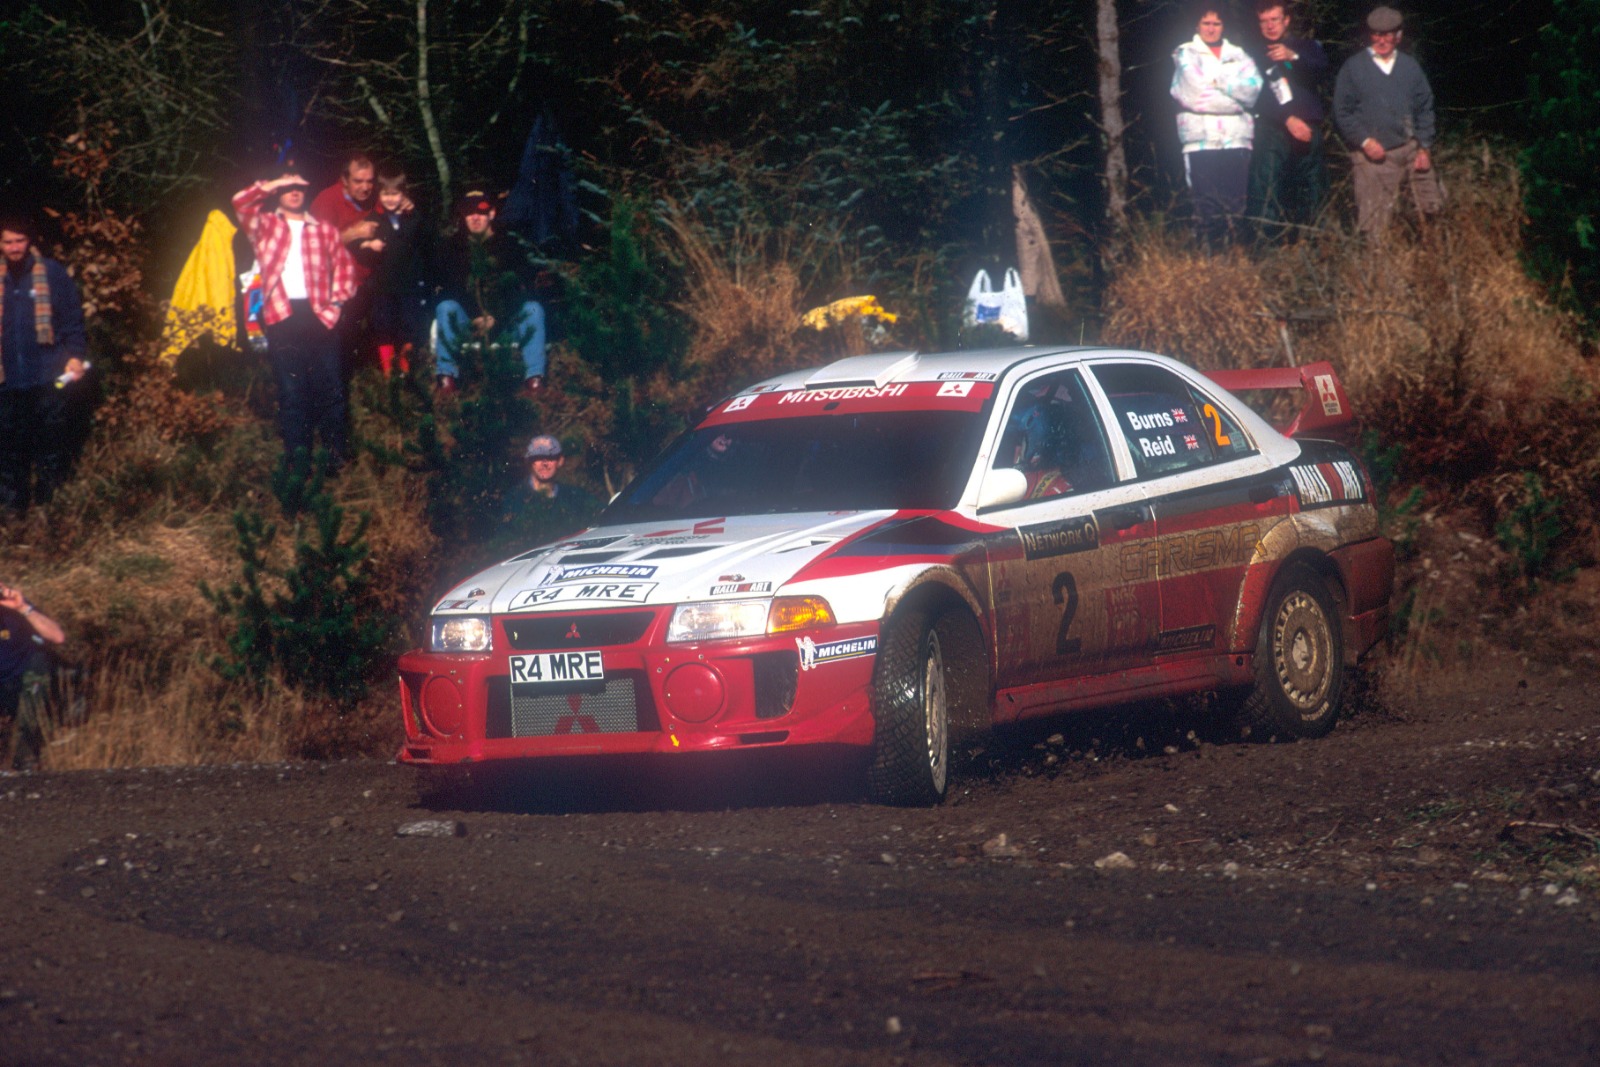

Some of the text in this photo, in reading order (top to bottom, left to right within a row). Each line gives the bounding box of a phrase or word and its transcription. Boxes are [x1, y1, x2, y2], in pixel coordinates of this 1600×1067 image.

[778, 384, 908, 405] MITSUBISHI
[1127, 408, 1174, 431] Burns
[1203, 403, 1231, 446] 2
[1139, 436, 1176, 458] Reid
[1084, 522, 1096, 543] Q
[1119, 524, 1268, 582] CARISMA
[563, 565, 654, 580] MICHELIN
[523, 584, 643, 605] R4 MRE
[1052, 571, 1082, 655] 2
[818, 638, 876, 658] MICHELIN
[511, 652, 603, 682] R4 MRE
